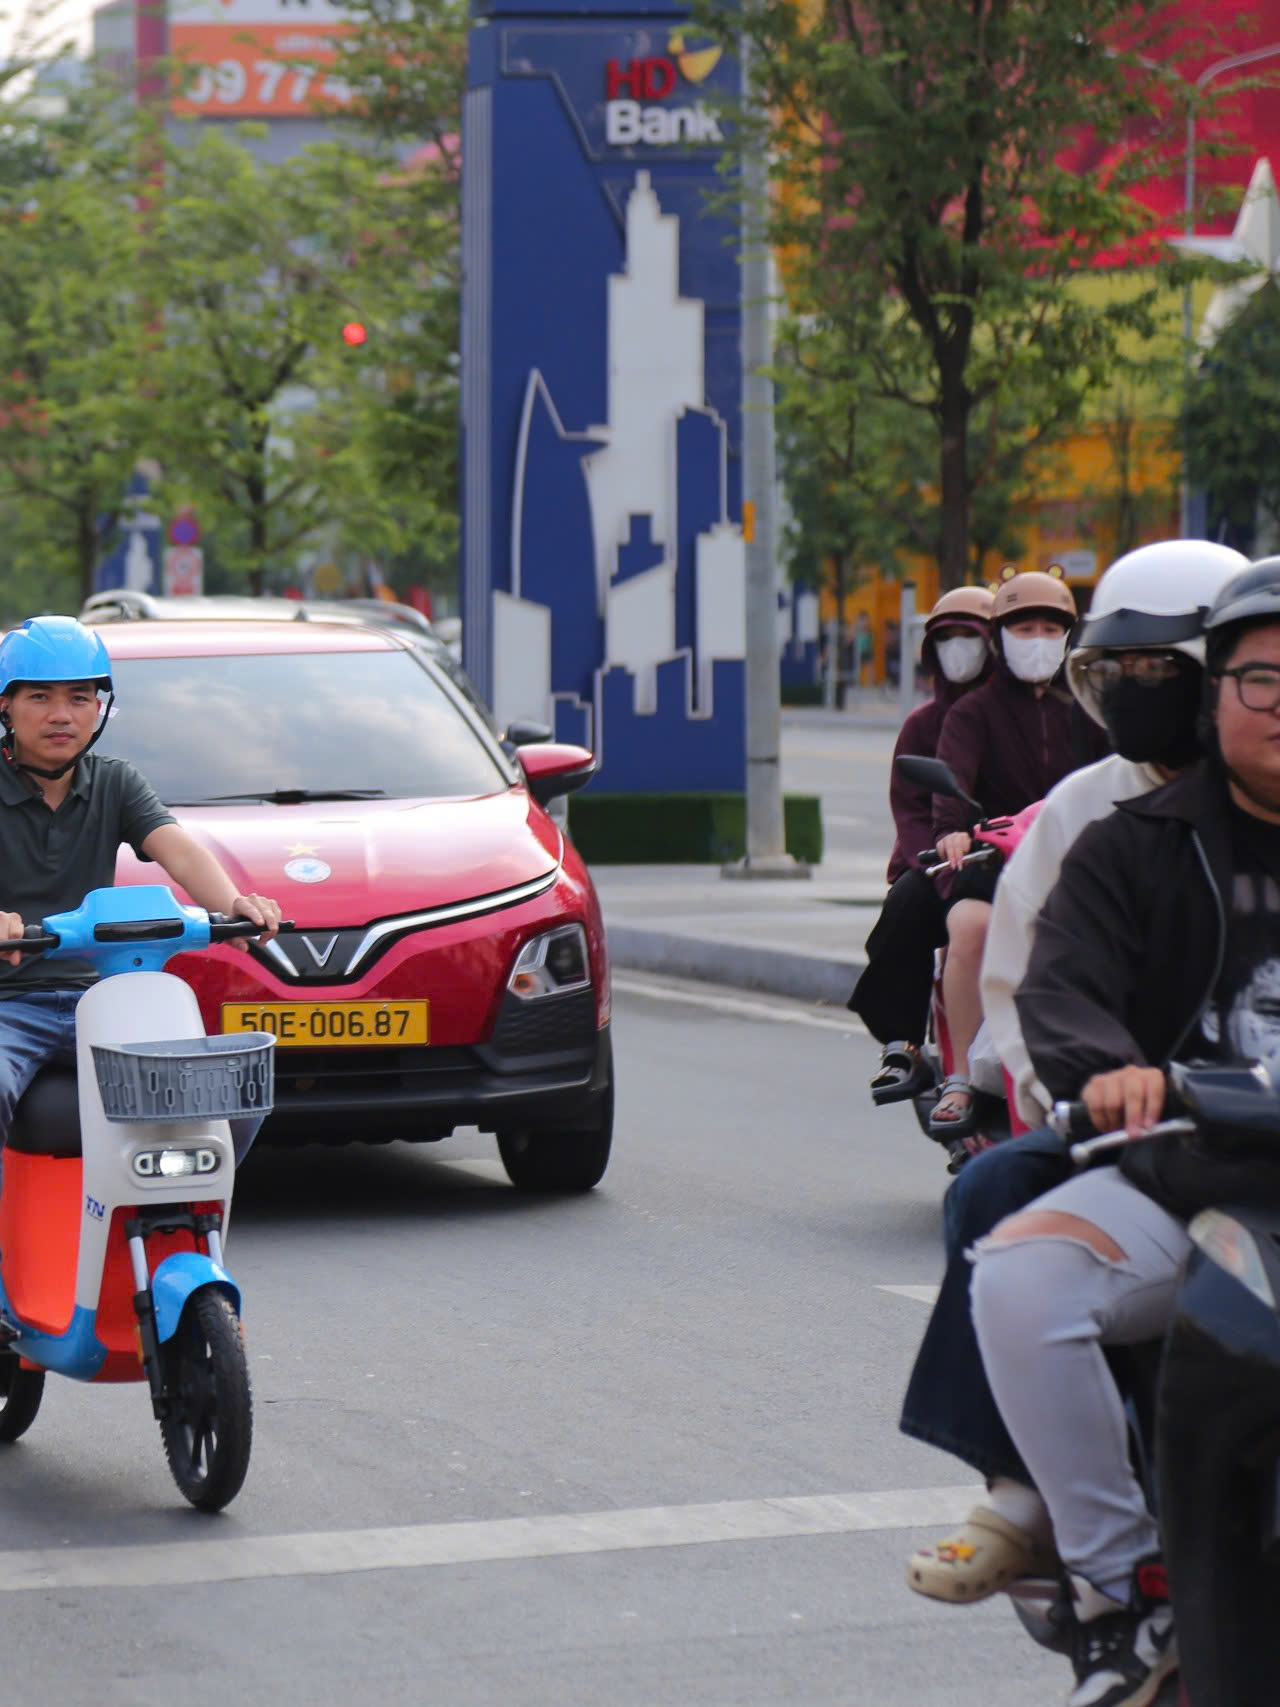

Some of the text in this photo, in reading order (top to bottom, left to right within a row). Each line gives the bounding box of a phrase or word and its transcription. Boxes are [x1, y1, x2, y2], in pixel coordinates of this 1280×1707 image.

[606, 57, 677, 100] HD
[606, 99, 724, 145] Bank
[241, 1010, 411, 1038] 50E-006.87
